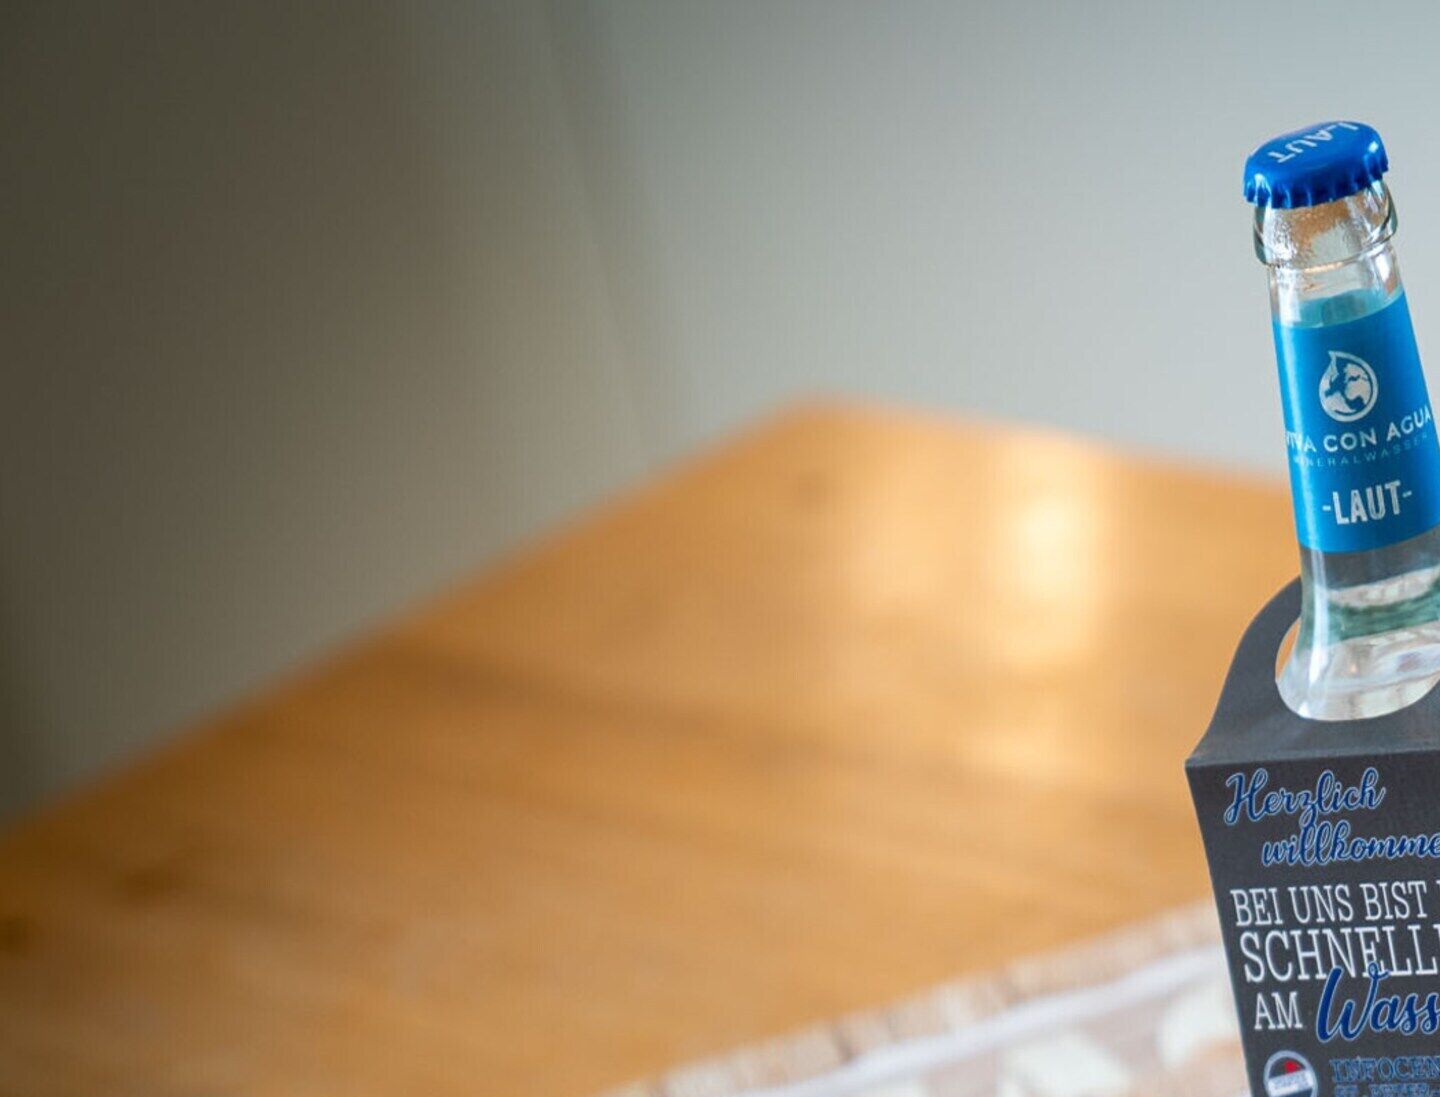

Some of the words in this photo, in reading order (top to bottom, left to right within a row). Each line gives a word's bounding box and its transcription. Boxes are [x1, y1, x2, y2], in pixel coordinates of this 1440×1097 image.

[1268, 122, 1359, 163] LAUT
[1323, 428, 1378, 453] CON
[1386, 404, 1432, 442] AGUA
[1225, 767, 1386, 832] Herzlich
[1231, 887, 1283, 927] BEI
[1288, 883, 1353, 924] UNS
[1362, 880, 1428, 922] BIST
[1254, 991, 1303, 1030] AM
